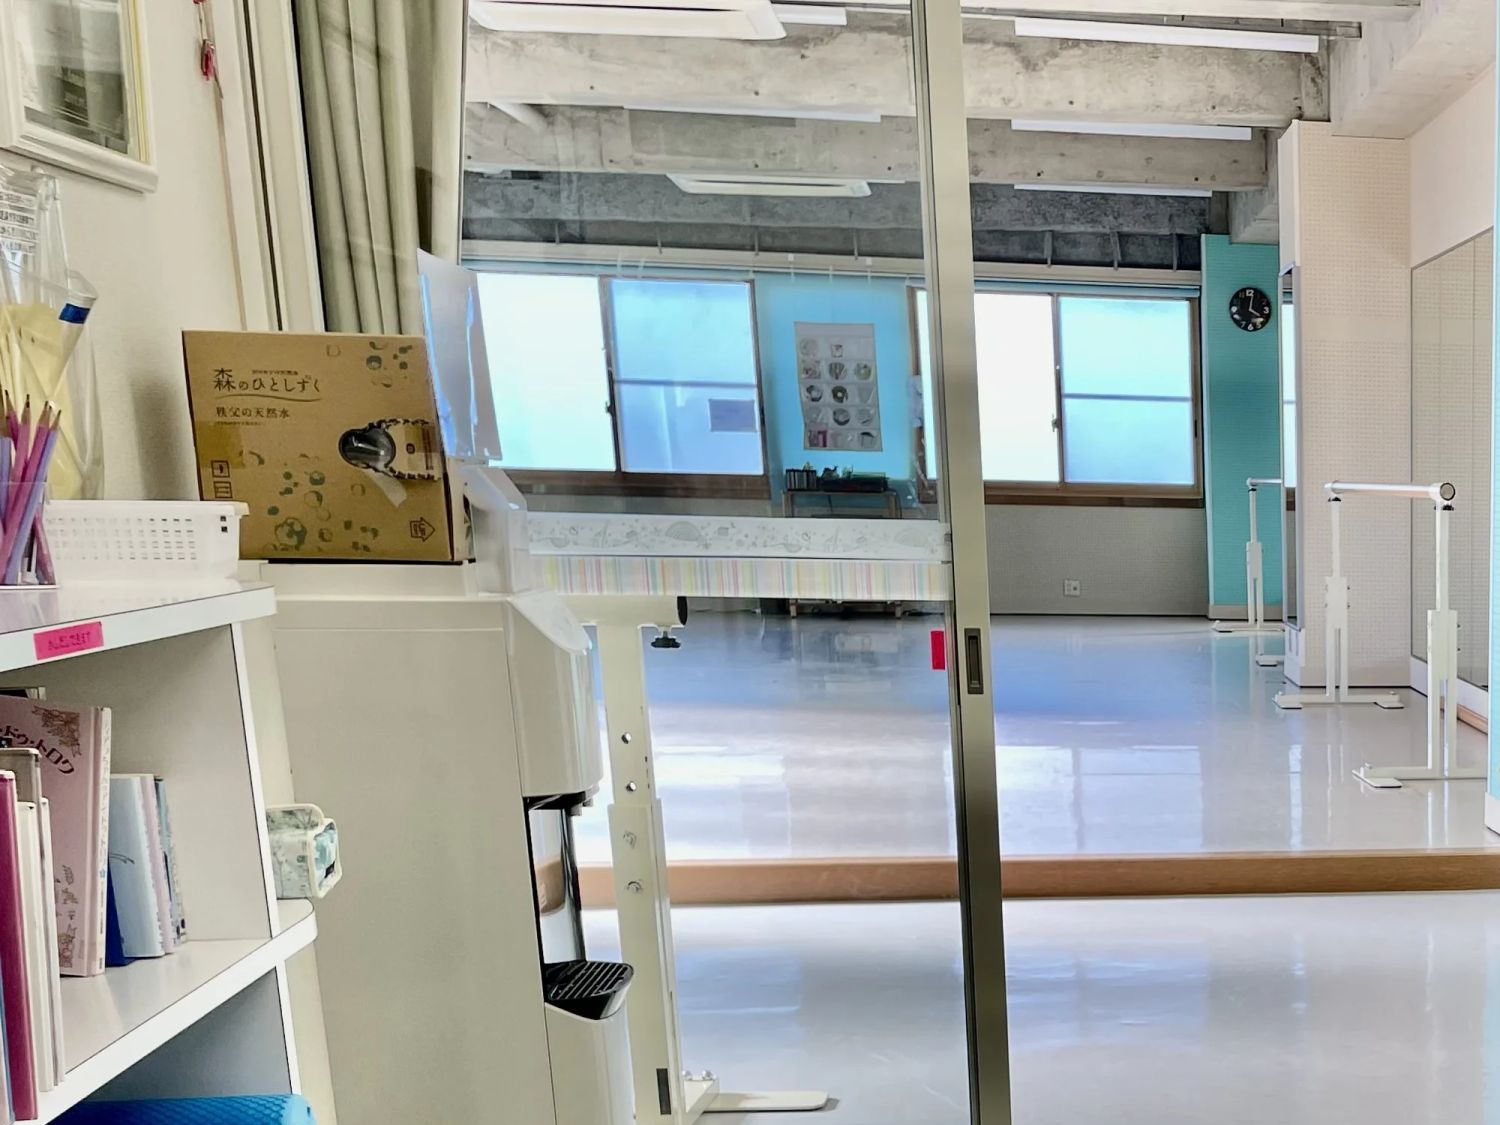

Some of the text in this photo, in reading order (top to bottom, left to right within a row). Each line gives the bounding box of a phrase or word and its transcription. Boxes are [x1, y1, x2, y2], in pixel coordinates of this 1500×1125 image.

[214, 368, 321, 393] 森のひとしずく
[216, 406, 290, 419] 秩父の天然水
